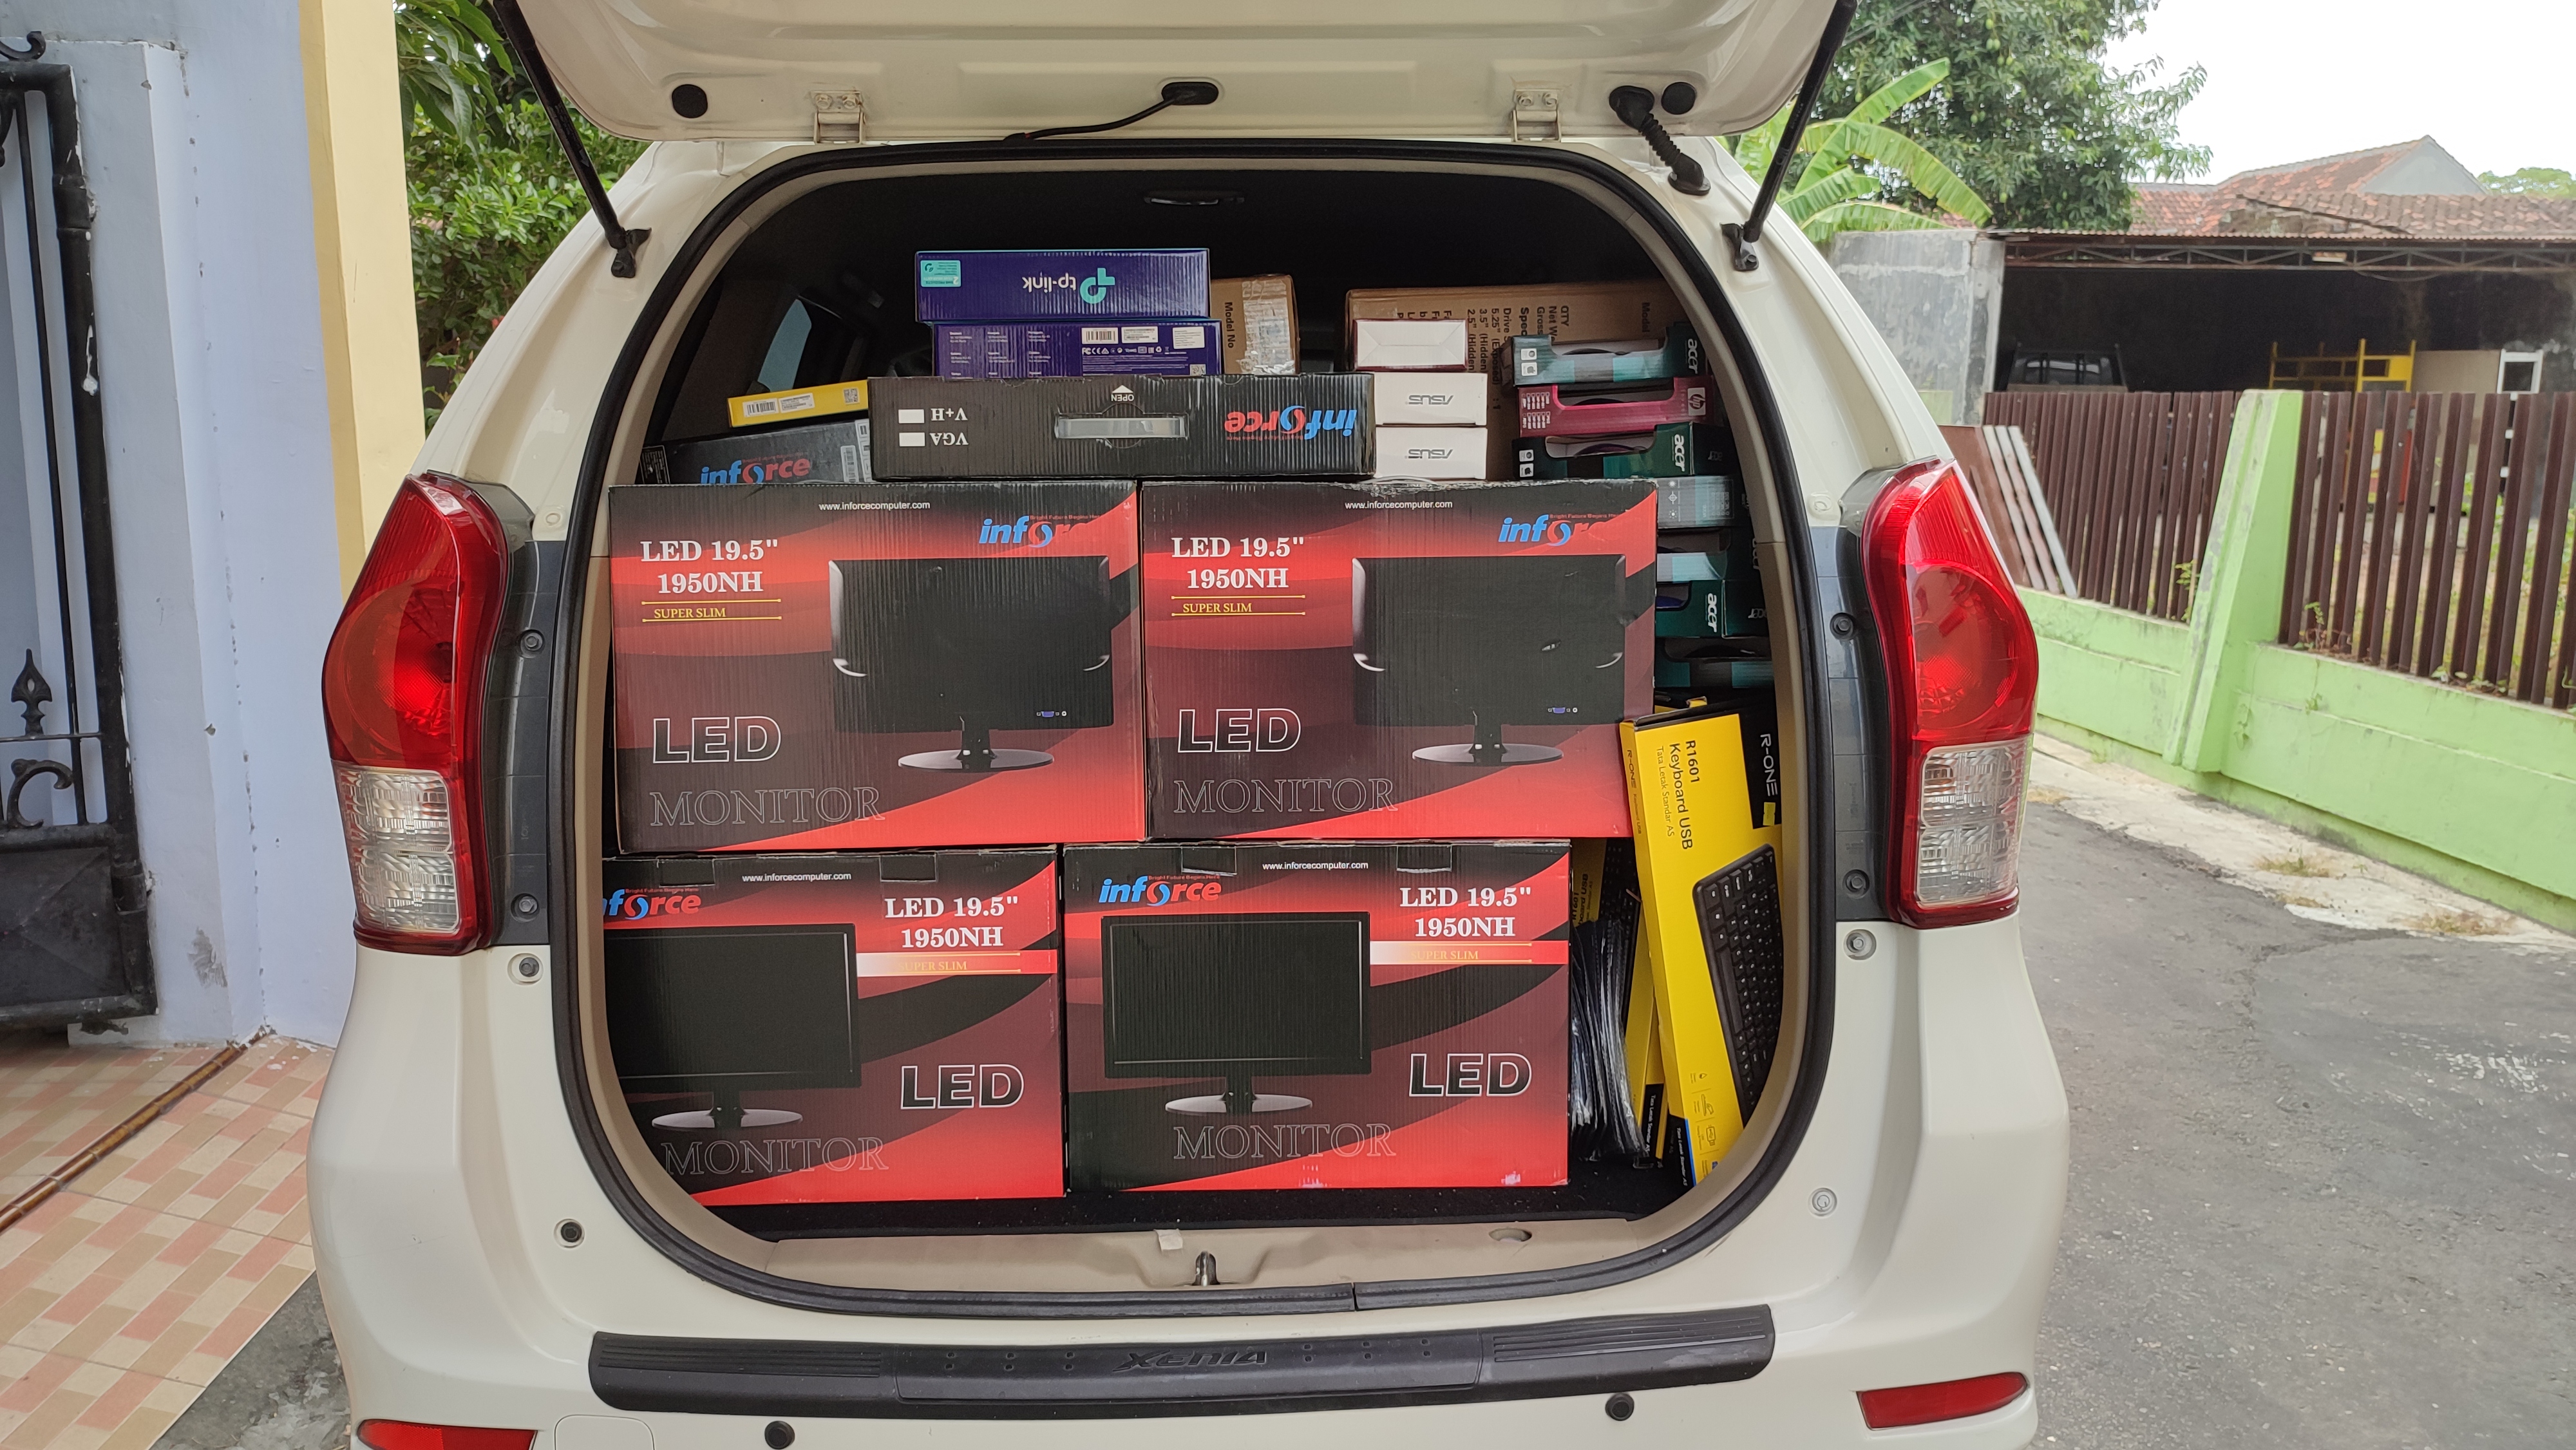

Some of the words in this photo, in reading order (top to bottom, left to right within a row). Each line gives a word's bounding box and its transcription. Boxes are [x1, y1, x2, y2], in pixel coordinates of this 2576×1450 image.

[1022, 272, 1076, 293] tp-link
[1224, 301, 1235, 331] Model
[1503, 308, 1511, 333] Drive
[1549, 306, 1557, 323] Net
[1560, 305, 1569, 326] QTY
[1642, 302, 1651, 333] Model
[1225, 335, 1235, 348] No
[1687, 338, 1698, 374] acer
[1110, 394, 1135, 402] OPEN
[1408, 395, 1454, 405] ASUS
[1688, 393, 1705, 410] hp
[931, 407, 968, 422] V+H
[1224, 405, 1357, 440] inforce
[929, 432, 969, 446] VGA
[1408, 449, 1454, 459] ASUS
[1674, 433, 1685, 472] acer
[701, 456, 810, 484] inforce
[819, 502, 931, 511] www.inforcecomputer.com
[1345, 500, 1453, 510] www.inforcecomputer.com
[641, 541, 703, 563] LED
[712, 539, 778, 561] 19.5"
[1171, 537, 1231, 559] LED
[1239, 536, 1305, 558] 19.5"
[658, 571, 763, 595] 1950NH
[1187, 568, 1289, 590] 1950NH
[654, 608, 694, 619] SUPER
[696, 608, 726, 618] SLIM
[1182, 603, 1221, 614] SUPER
[1222, 603, 1253, 613] SLIM
[1708, 593, 1718, 633] acer
[652, 715, 782, 765] LED
[1177, 708, 1302, 754] LED
[1627, 749, 1637, 789] R-ONE
[1685, 740, 1700, 783] R1601
[1760, 733, 1778, 796] R-ONE
[1658, 766, 1669, 789] Letak
[650, 787, 886, 827] MONITOR
[1173, 778, 1398, 814] MONITOR
[1662, 791, 1671, 823] Standar
[1669, 742, 1689, 814] Keyboard
[1679, 817, 1693, 850] USB
[1667, 825, 1674, 837] AS
[742, 872, 852, 883] www.inforcecomputer.com
[1262, 861, 1368, 871] www.inforcecomputer.com
[1099, 876, 1222, 907] inforce
[1400, 888, 1459, 908] LED
[1467, 886, 1531, 907] 19.5"
[603, 889, 701, 920] force
[885, 898, 945, 919] LED
[953, 896, 1018, 917] 19.5"
[901, 927, 1004, 948] 1950NH
[1414, 917, 1516, 937] 1950NH
[898, 961, 936, 972] SUPER
[938, 961, 967, 970] SLIM
[1410, 950, 1448, 961] SUPER
[1450, 950, 1479, 960] SLIM
[1408, 1053, 1533, 1097] LED
[900, 1064, 1025, 1110] LED
[1173, 1123, 1396, 1160] MONITOR
[661, 1136, 889, 1176] MONITOR
[1112, 1349, 1267, 1372] XENIA
